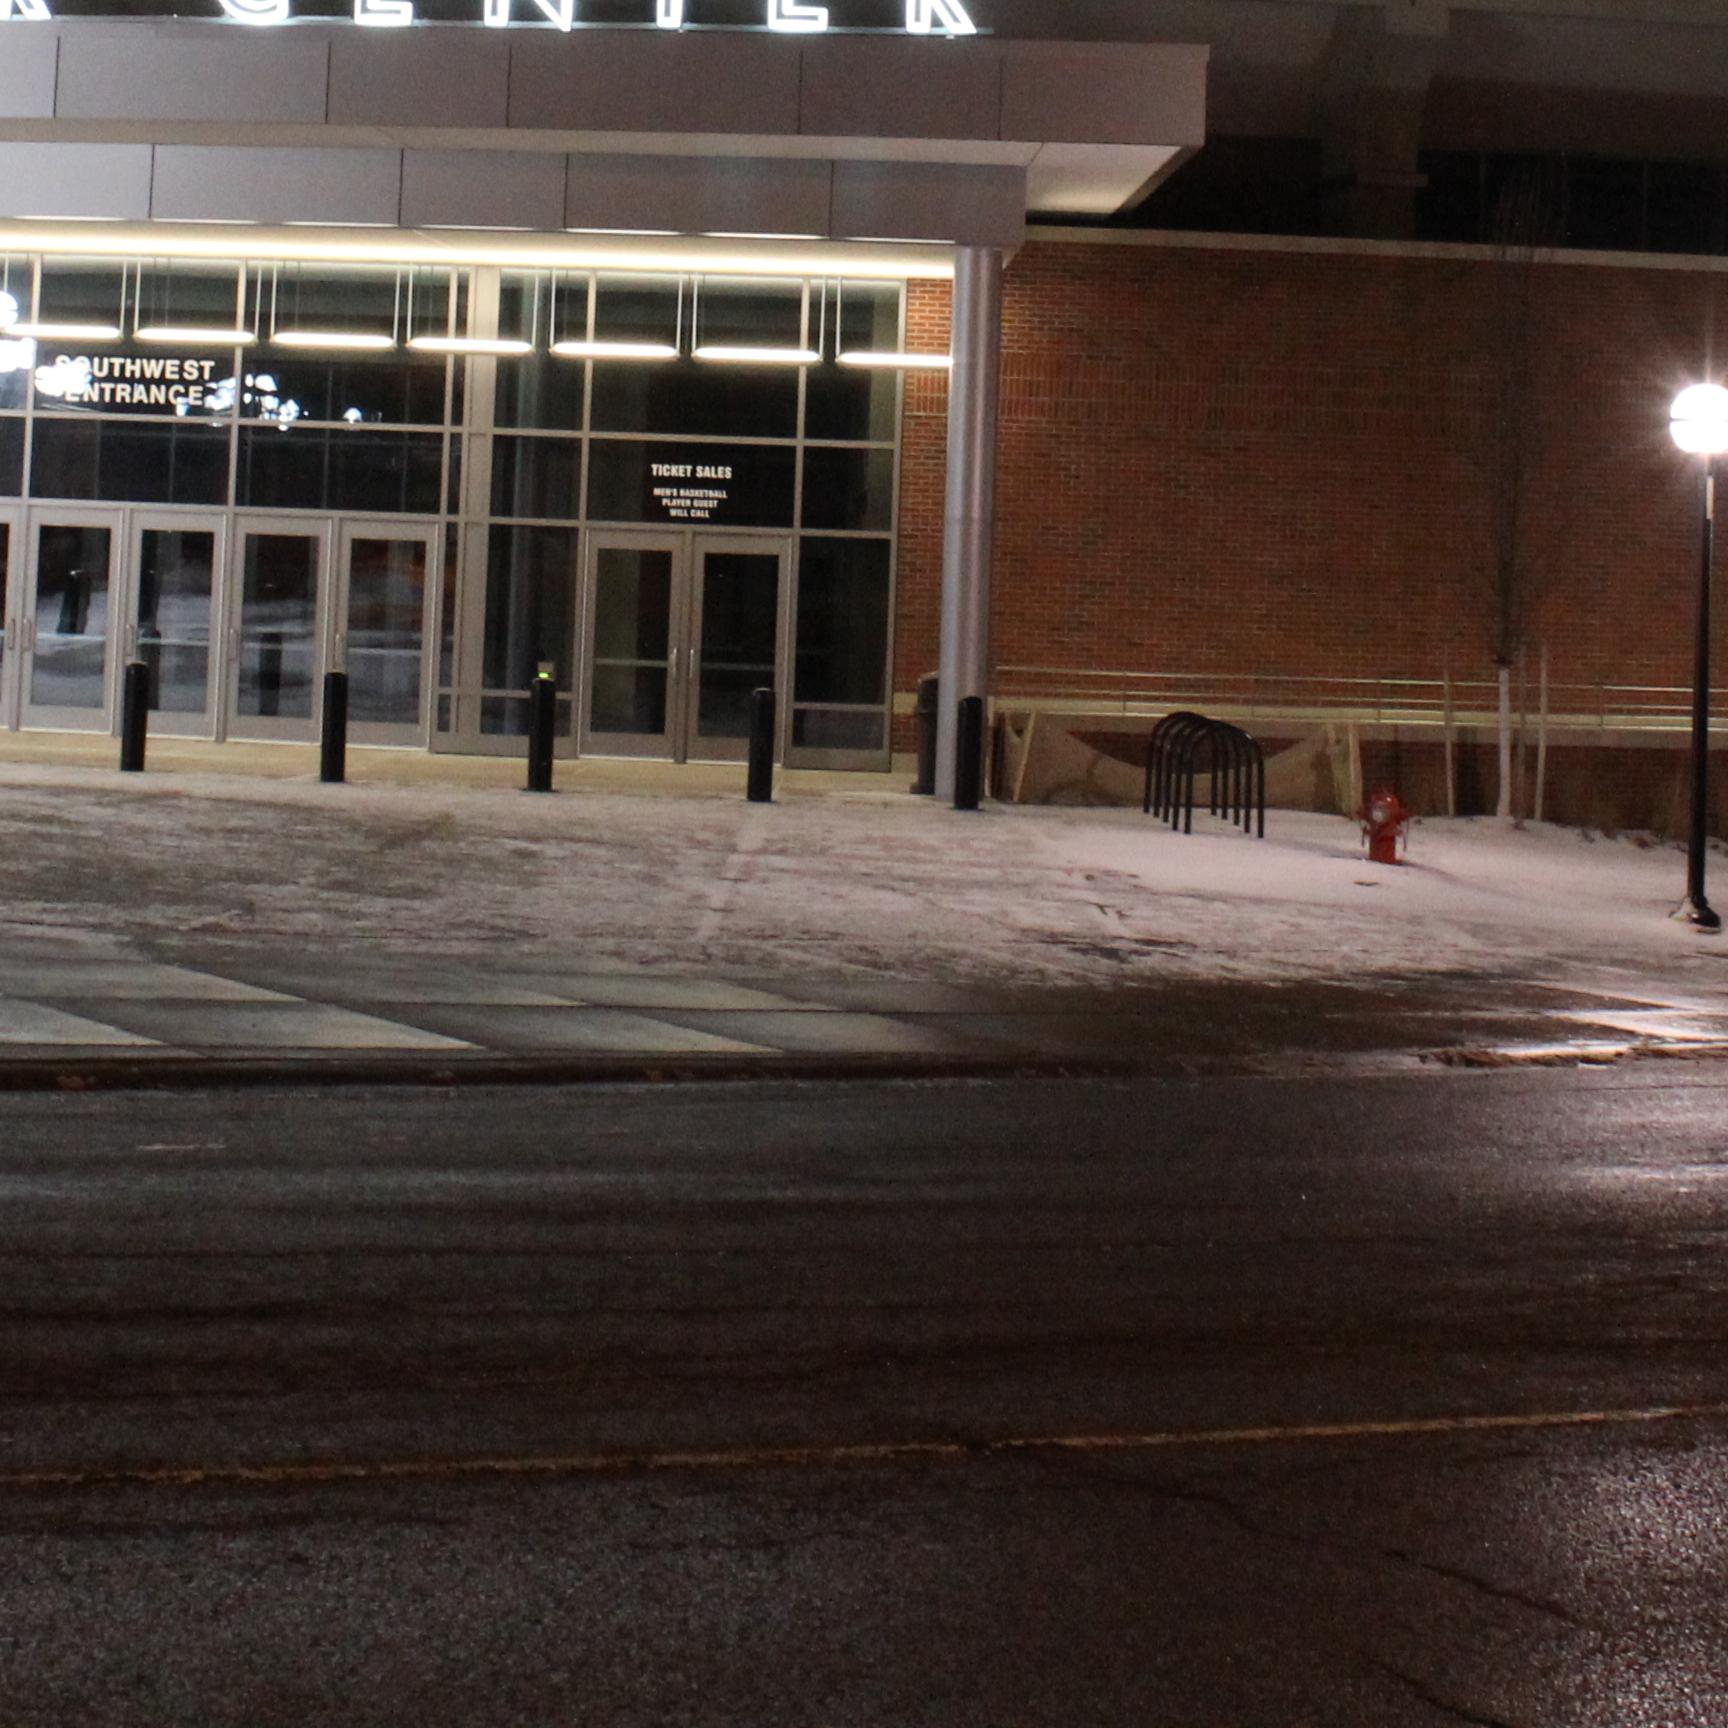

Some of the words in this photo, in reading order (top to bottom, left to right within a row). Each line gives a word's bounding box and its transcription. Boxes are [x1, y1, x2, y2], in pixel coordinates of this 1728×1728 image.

[651, 464, 692, 478] TICKET
[696, 465, 732, 479] SALES
[679, 488, 728, 499] BASKETBALL
[662, 498, 691, 507] PLAYER
[669, 508, 688, 517] WILL
[690, 508, 710, 518] CALL
